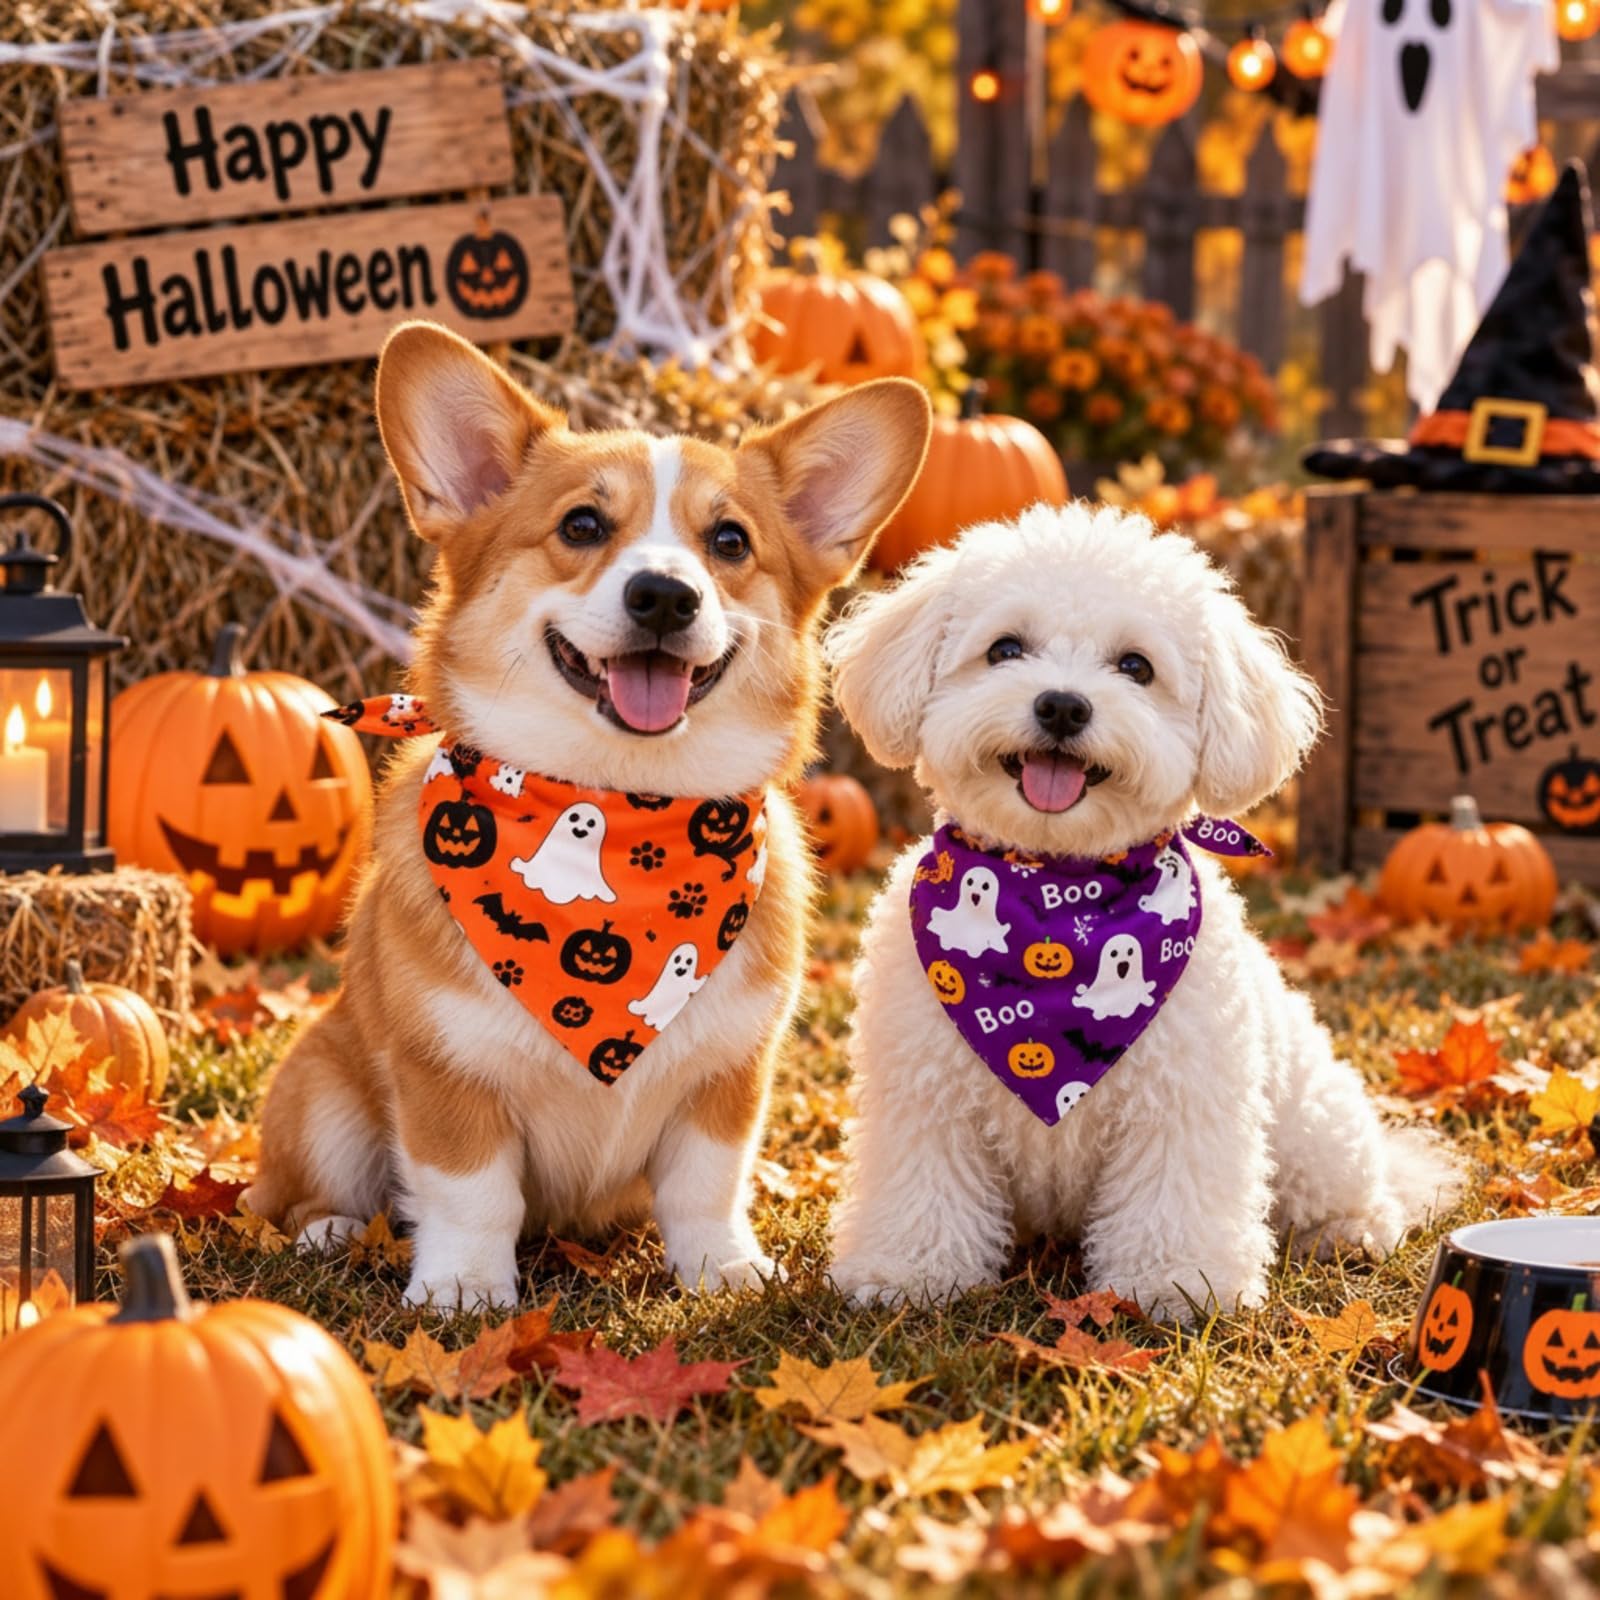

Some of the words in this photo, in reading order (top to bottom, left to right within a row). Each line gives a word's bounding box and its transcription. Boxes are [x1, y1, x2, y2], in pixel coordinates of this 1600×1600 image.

[163, 106, 392, 200] Happy
[102, 244, 438, 351] Halloween
[1411, 550, 1577, 653] Trick
[1480, 648, 1526, 687] or
[1429, 663, 1596, 775] Treat
[1042, 881, 1102, 909] Boo
[975, 1000, 1034, 1034] Boo
